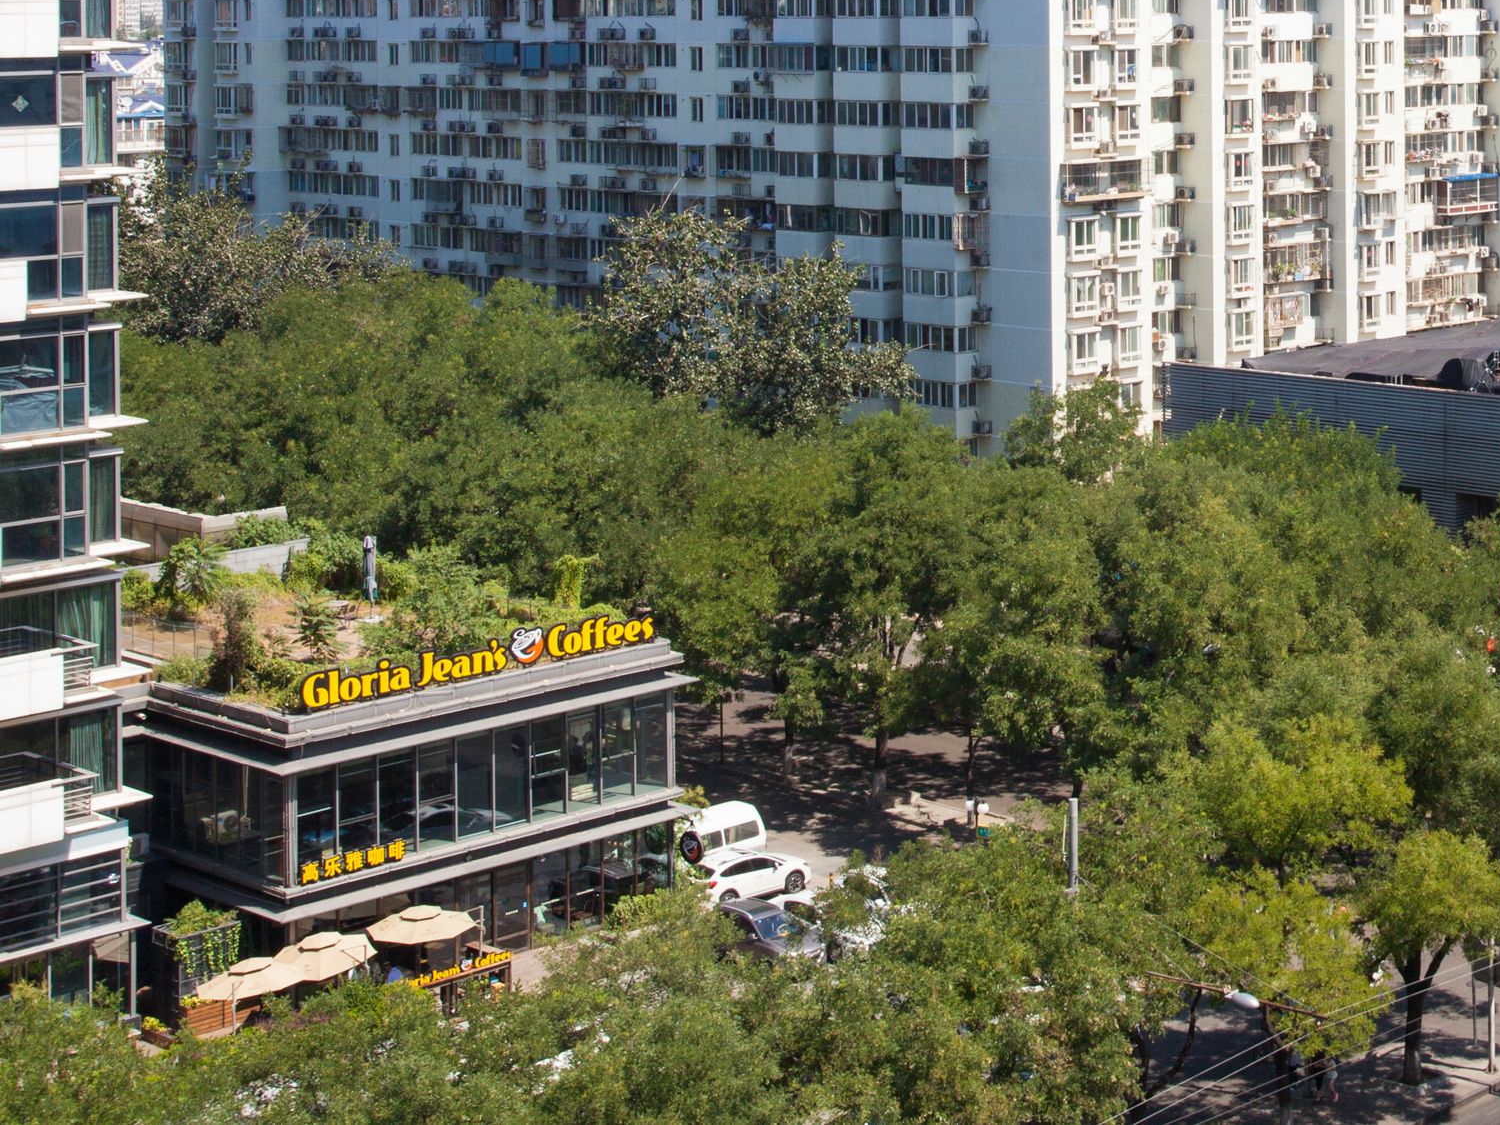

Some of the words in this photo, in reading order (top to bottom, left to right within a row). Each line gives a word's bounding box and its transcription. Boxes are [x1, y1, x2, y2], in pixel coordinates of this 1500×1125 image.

[302, 660, 411, 708] Gloria
[417, 639, 507, 687] Jean's
[547, 615, 654, 658] Coffees
[302, 839, 406, 884] 高乐雅咖啡
[432, 964, 460, 982] Jean's
[475, 951, 511, 968] Coffees
